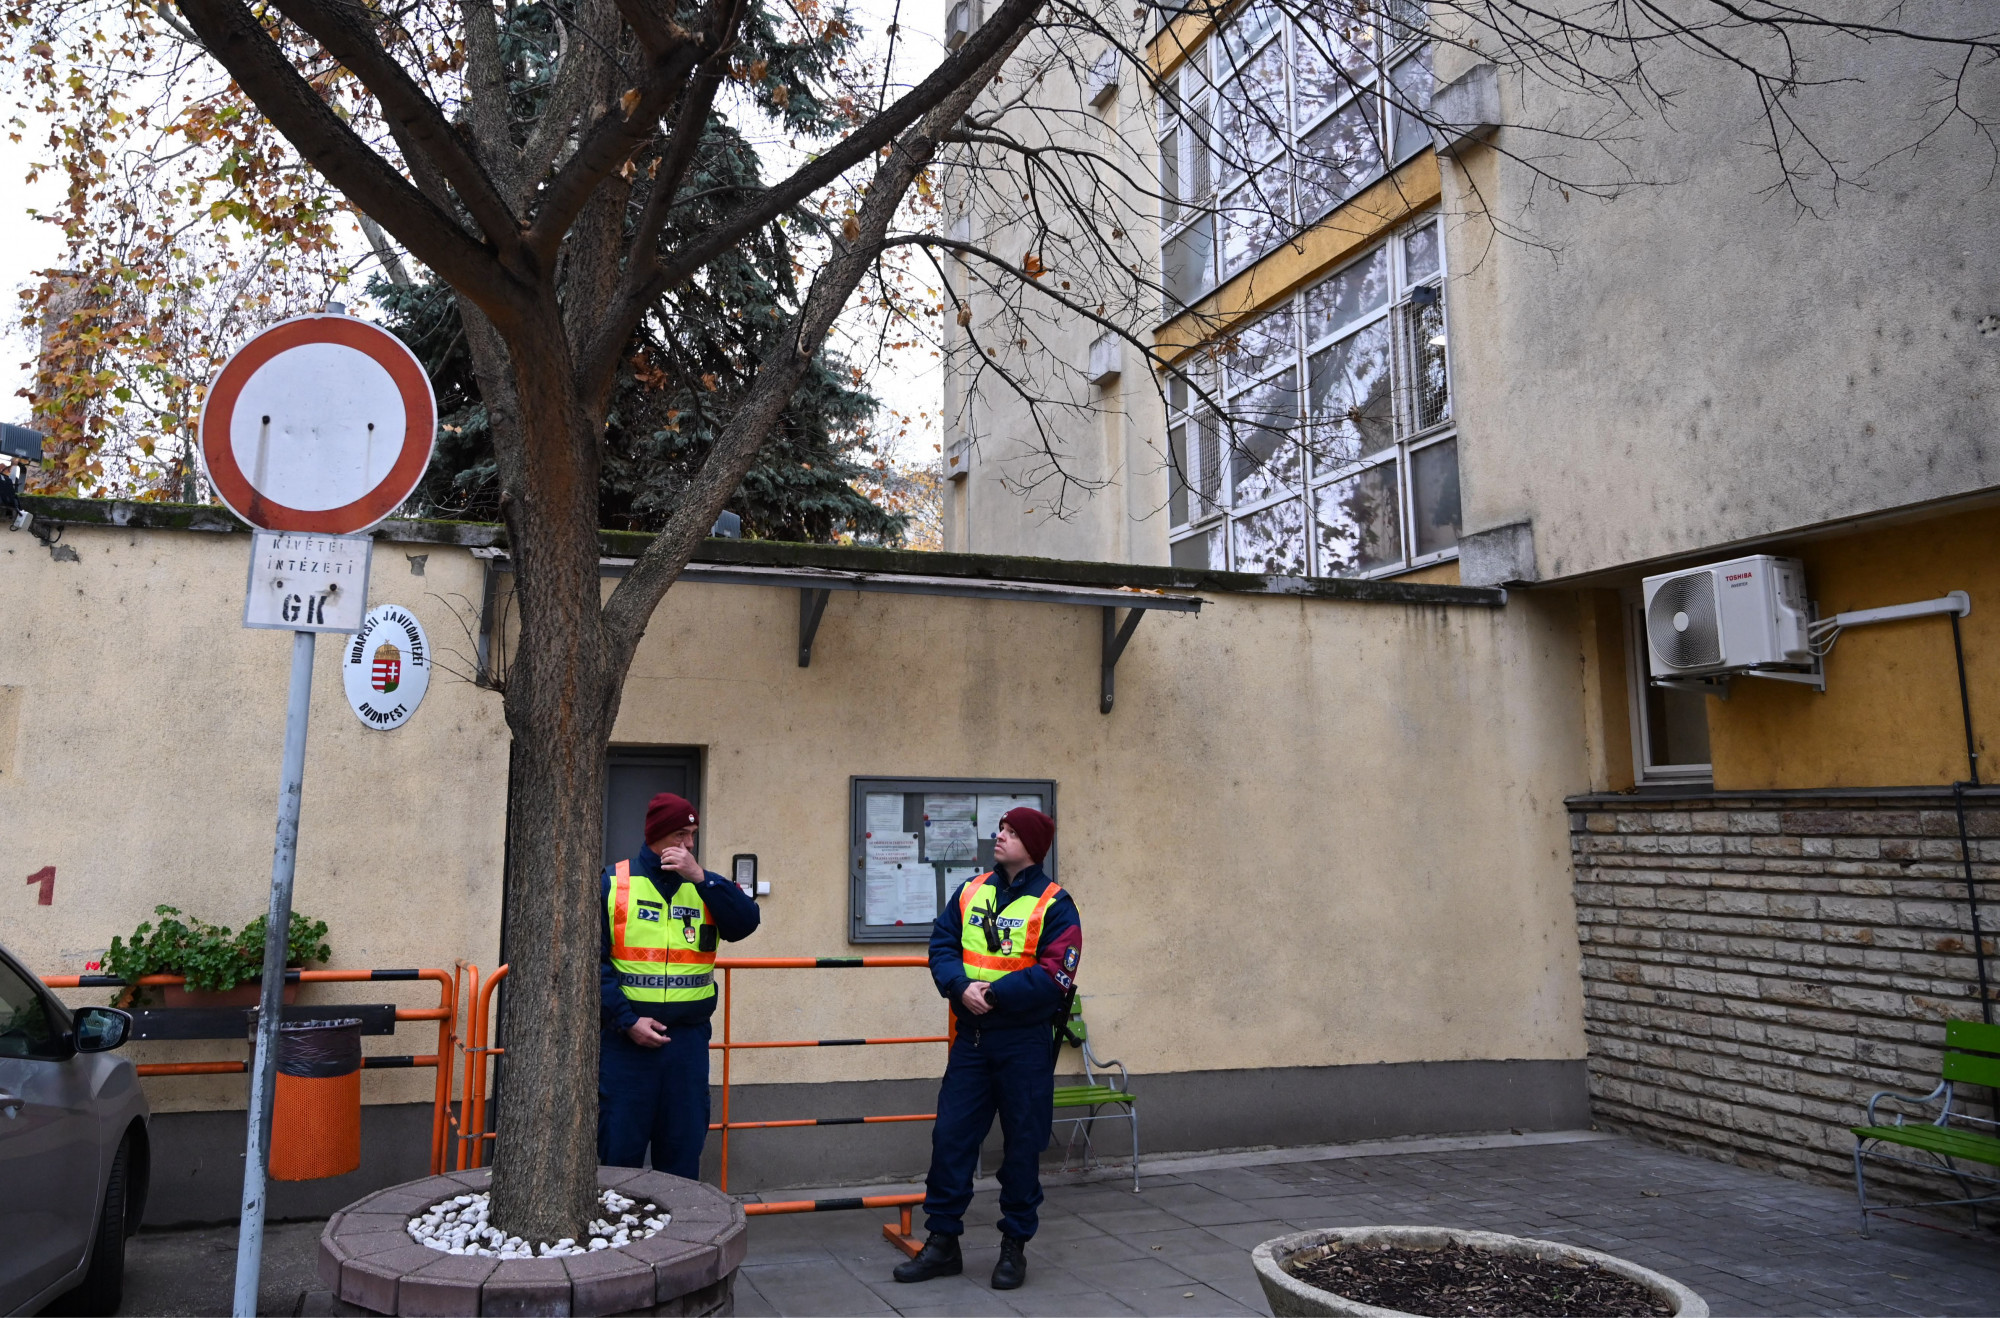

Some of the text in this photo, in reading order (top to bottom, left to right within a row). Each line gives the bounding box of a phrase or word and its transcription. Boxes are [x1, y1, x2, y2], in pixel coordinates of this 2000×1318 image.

[1725, 572, 1752, 581] TOSHIBA
[282, 594, 328, 625] GK
[350, 610, 424, 667] BUDAPESTI JAVÍTÓINTÉZET
[359, 702, 408, 724] BUDAPEST
[26, 865, 57, 906] 1
[673, 907, 700, 917] POLICE
[998, 917, 1024, 927] POLICE
[620, 974, 664, 986] POLICE
[667, 974, 706, 986] POLICE
